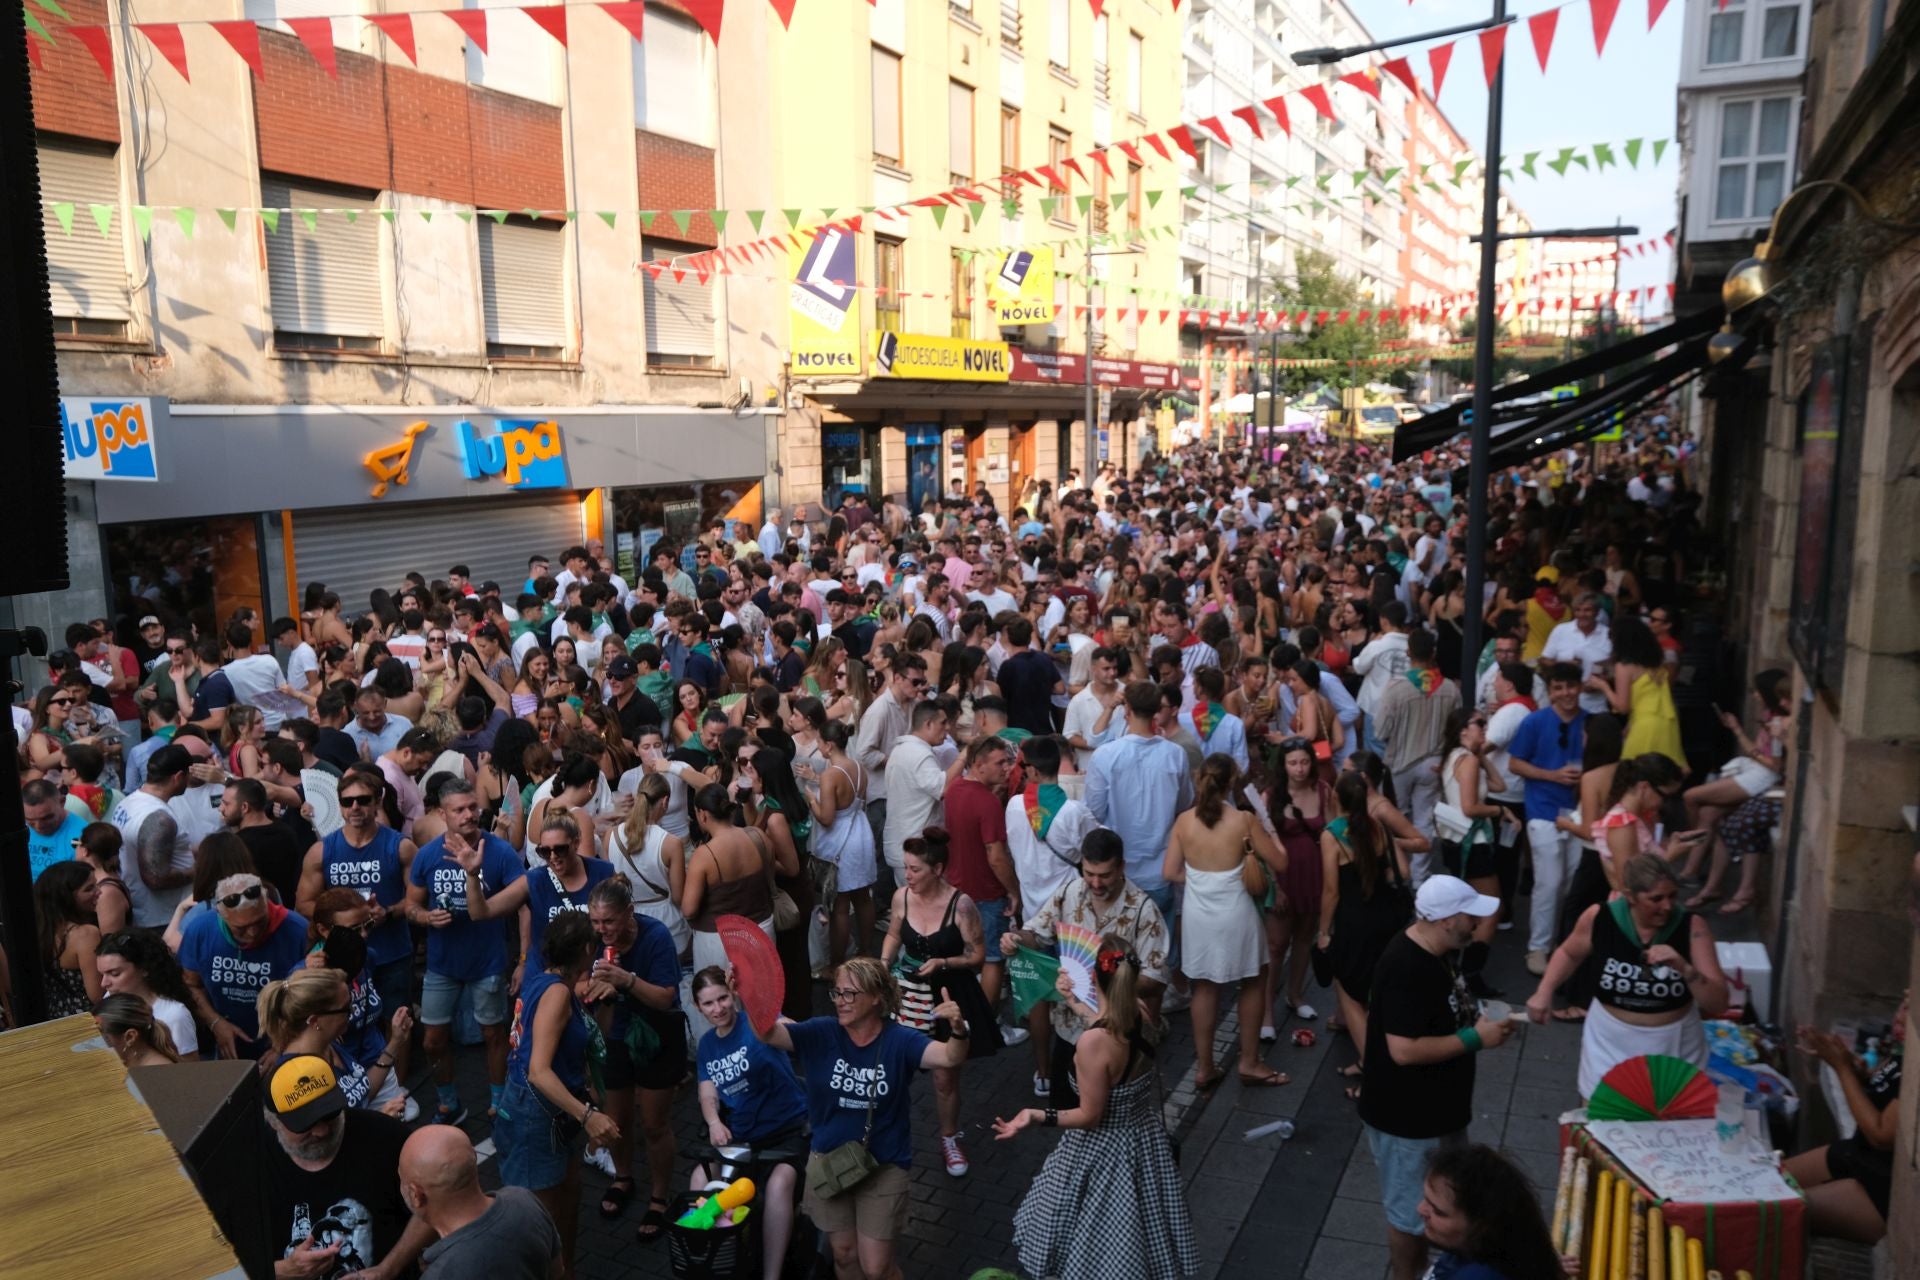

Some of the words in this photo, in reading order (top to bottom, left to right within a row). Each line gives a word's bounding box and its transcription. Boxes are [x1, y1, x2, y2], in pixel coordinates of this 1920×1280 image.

[1002, 306, 1048, 320] NOVEL
[798, 352, 855, 366] NOVEL
[893, 344, 959, 368] AUTOESCUELA
[963, 347, 1004, 374] NOVEL
[60, 402, 148, 471] lupa
[456, 420, 561, 484] lupa
[330, 872, 381, 885] 39300
[211, 969, 271, 987] 39300
[1010, 968, 1040, 980] rande
[1599, 973, 1685, 997] 39300
[711, 1058, 750, 1087] 39300
[284, 1074, 330, 1107] INDOMABLE
[829, 1074, 889, 1098] 39300
